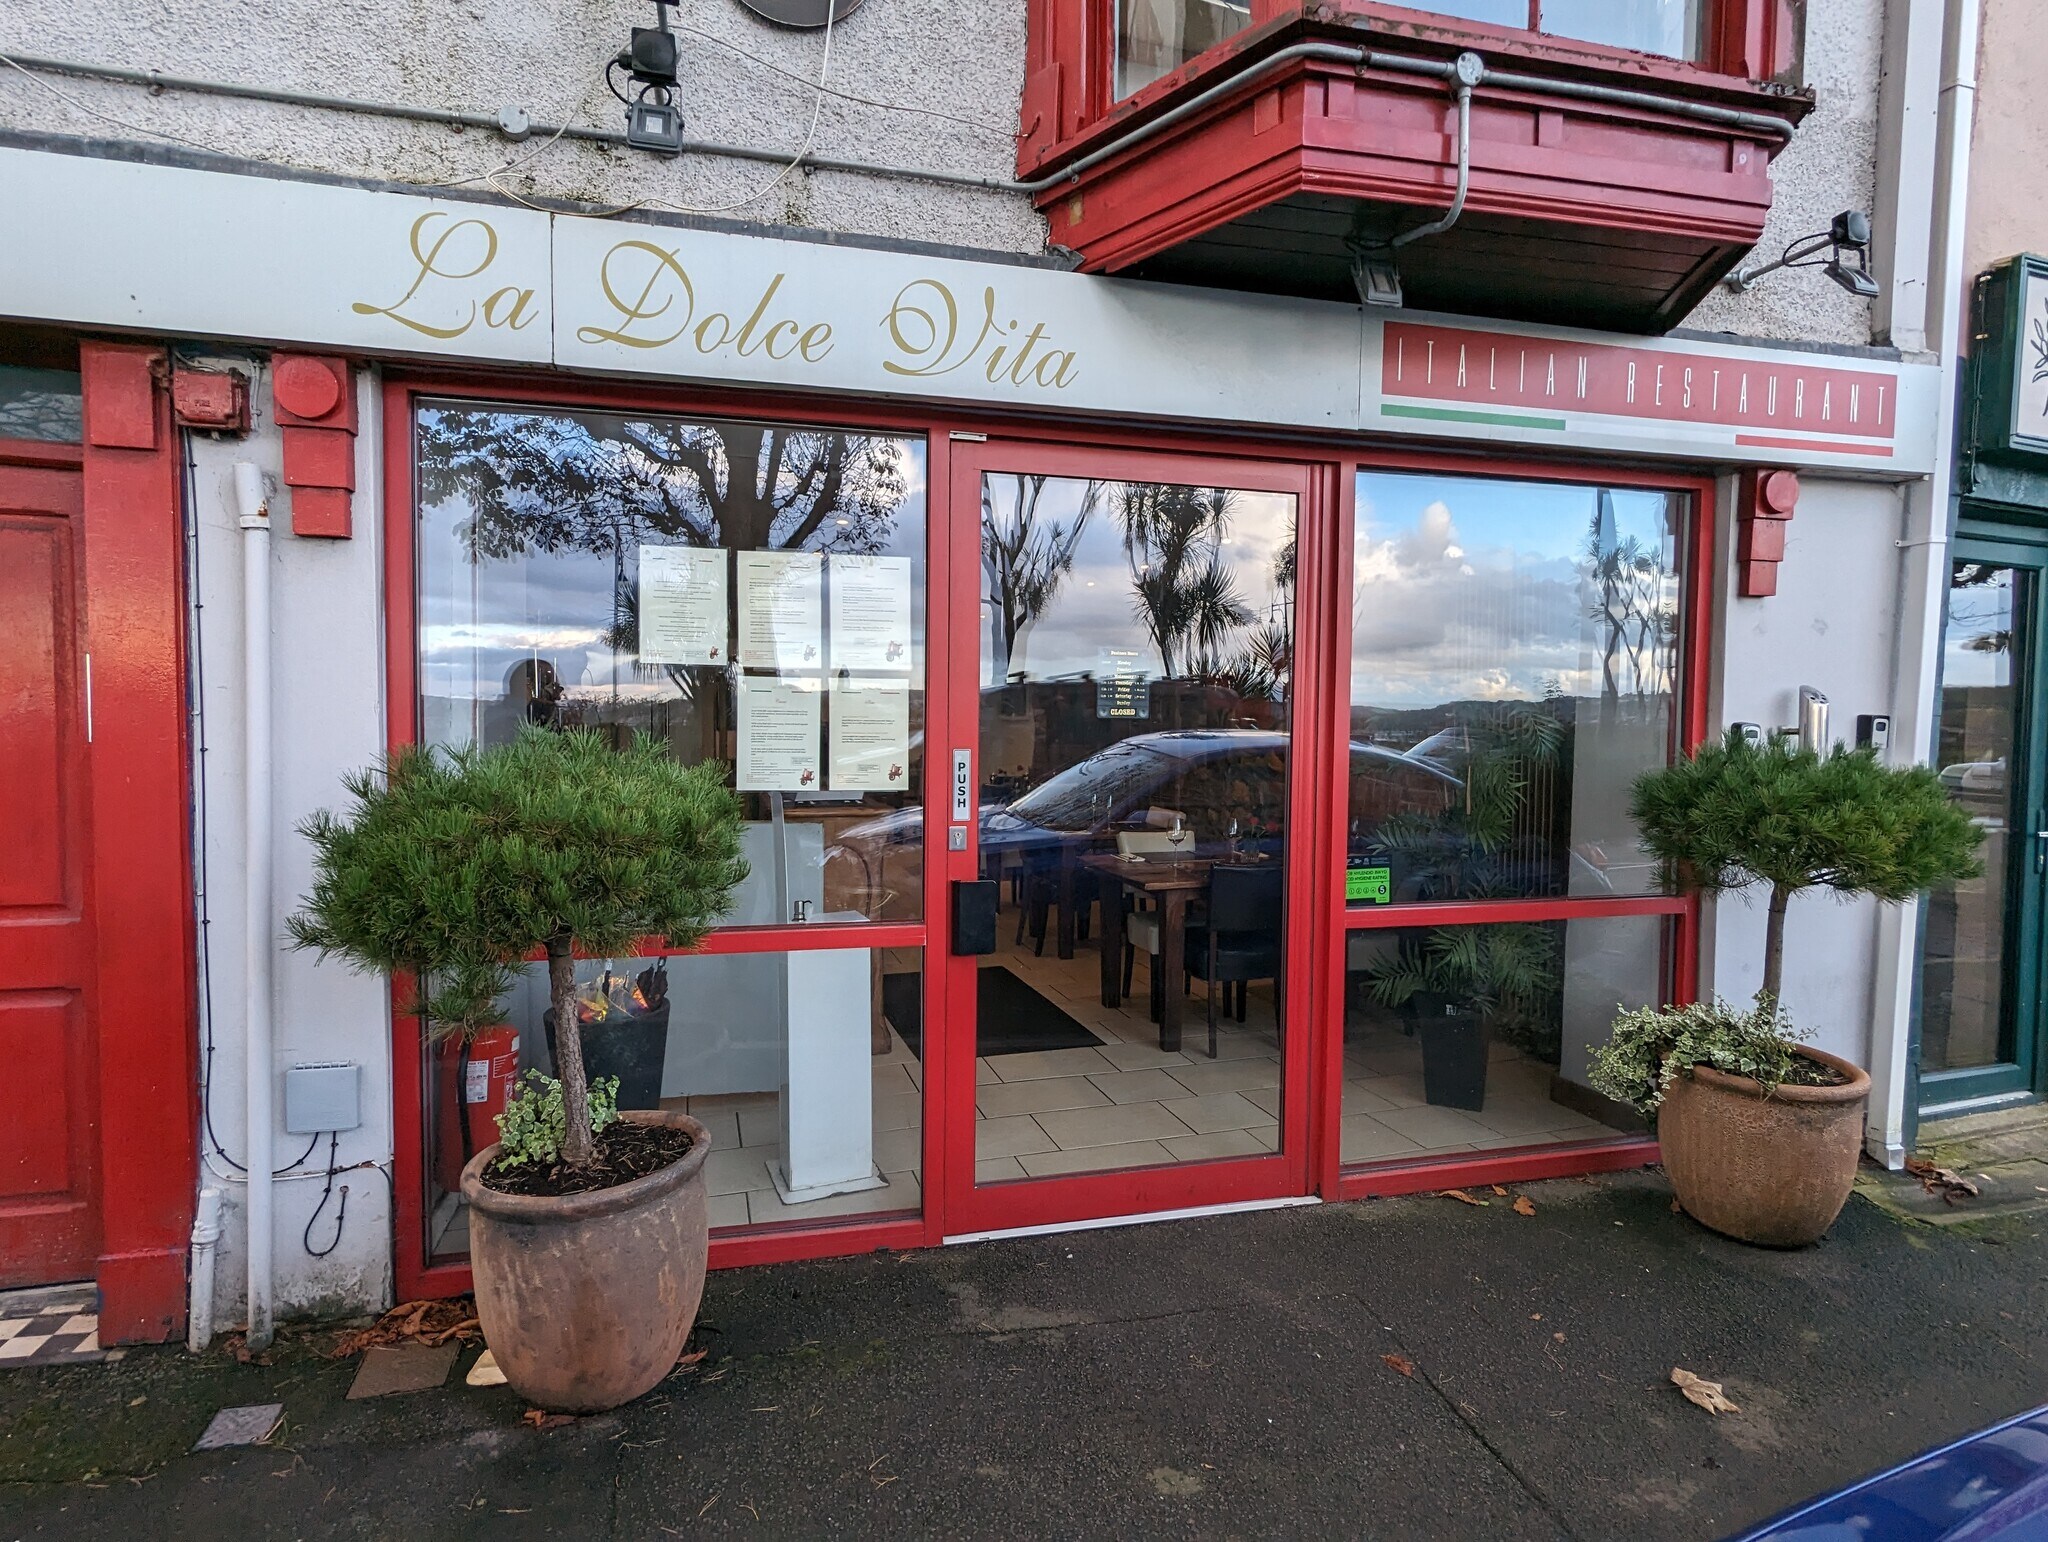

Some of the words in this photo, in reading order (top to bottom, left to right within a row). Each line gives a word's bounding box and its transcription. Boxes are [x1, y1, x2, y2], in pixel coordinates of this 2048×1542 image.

[352, 212, 539, 339] La
[576, 239, 834, 364] Dolce
[878, 278, 1080, 391] Vita
[1396, 336, 1587, 399] ITALIAN
[1626, 361, 1886, 425] RESTAURANT
[957, 761, 966, 808] PUSH
